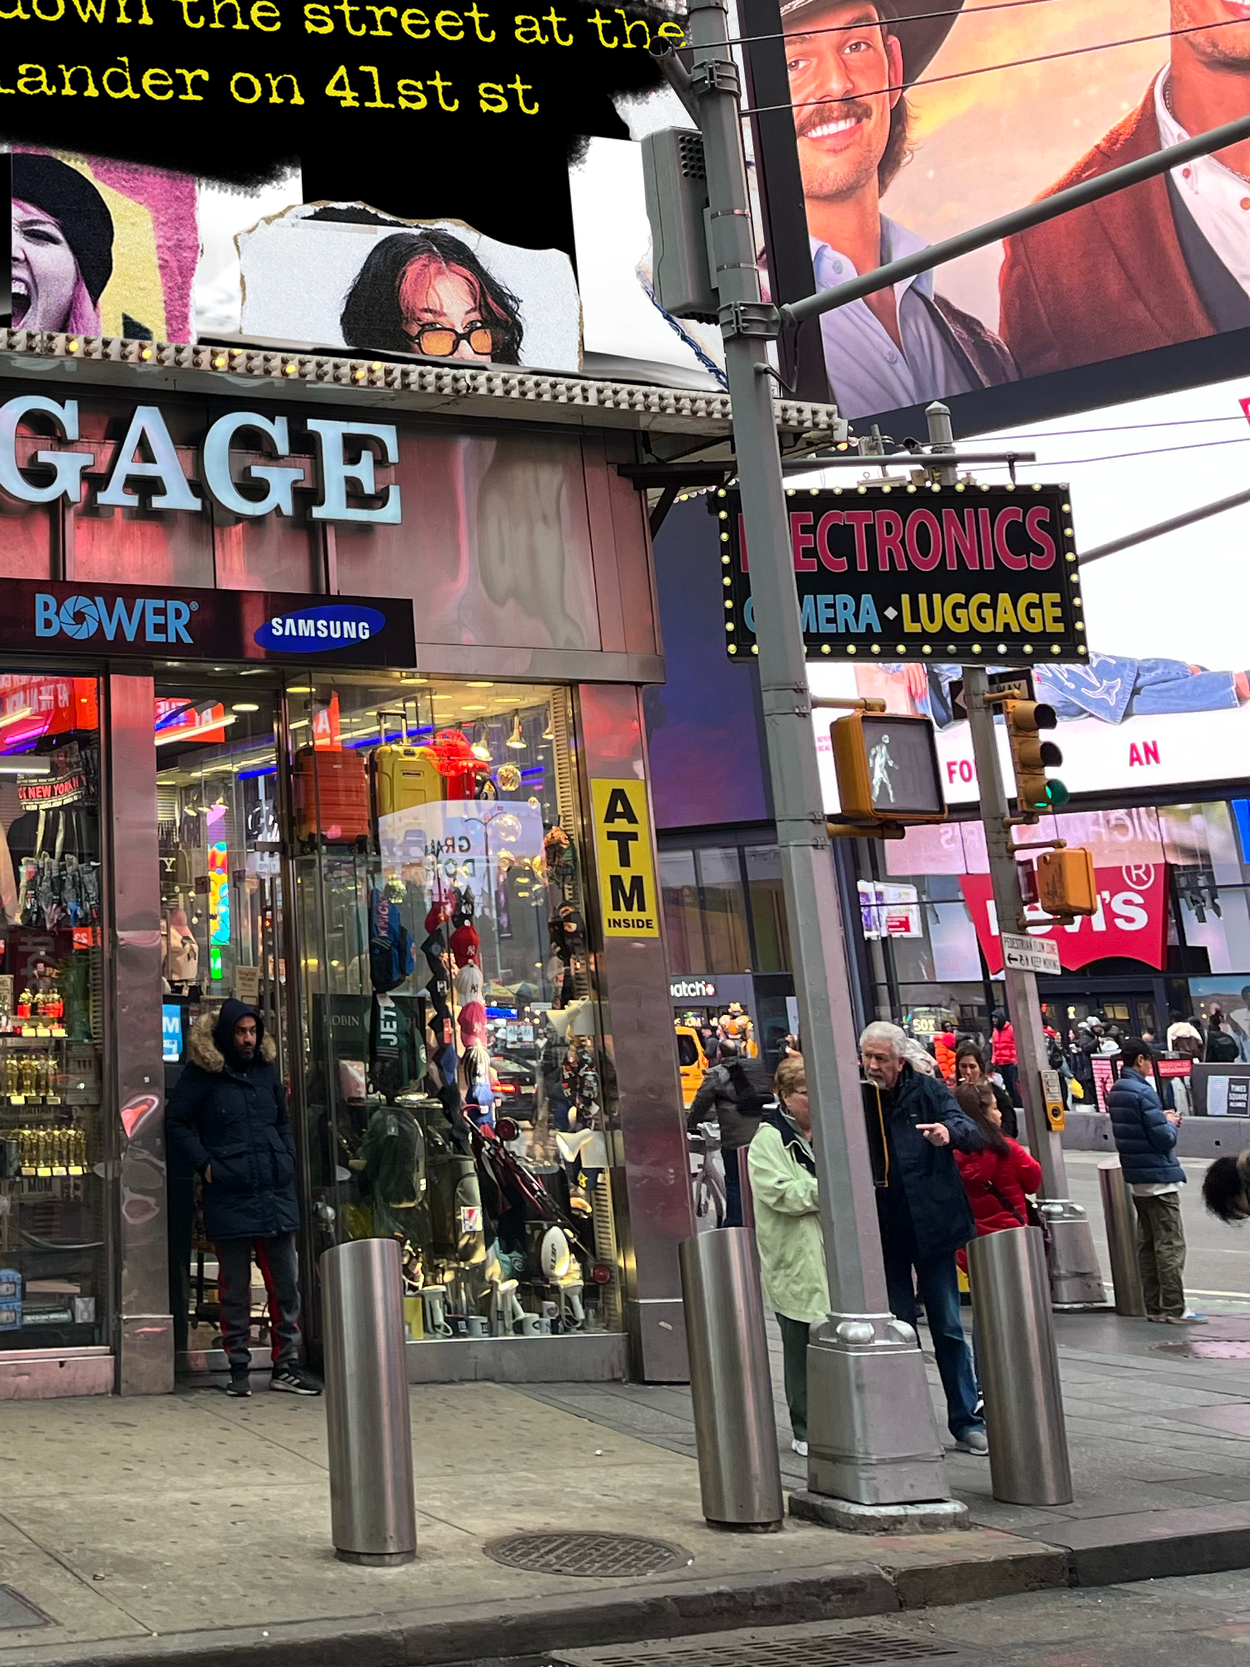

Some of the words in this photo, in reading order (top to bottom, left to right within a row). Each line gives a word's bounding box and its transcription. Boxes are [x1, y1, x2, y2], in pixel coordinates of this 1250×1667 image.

[513, 5, 575, 48] at
[586, 7, 688, 51] the
[229, 70, 306, 106] on
[324, 63, 461, 113] 41st
[477, 72, 541, 116] st
[738, 506, 1056, 573] ECTRONICS
[271, 615, 371, 640] SAMSUNG
[901, 592, 1065, 633] LUGGAGE
[947, 760, 978, 785] FO
[1129, 740, 1161, 767] AN
[28, 785, 52, 799] NEW
[604, 788, 647, 912] ATM
[607, 918, 654, 929] INSIDE
[1003, 936, 1033, 951] PEDESTRIAN
